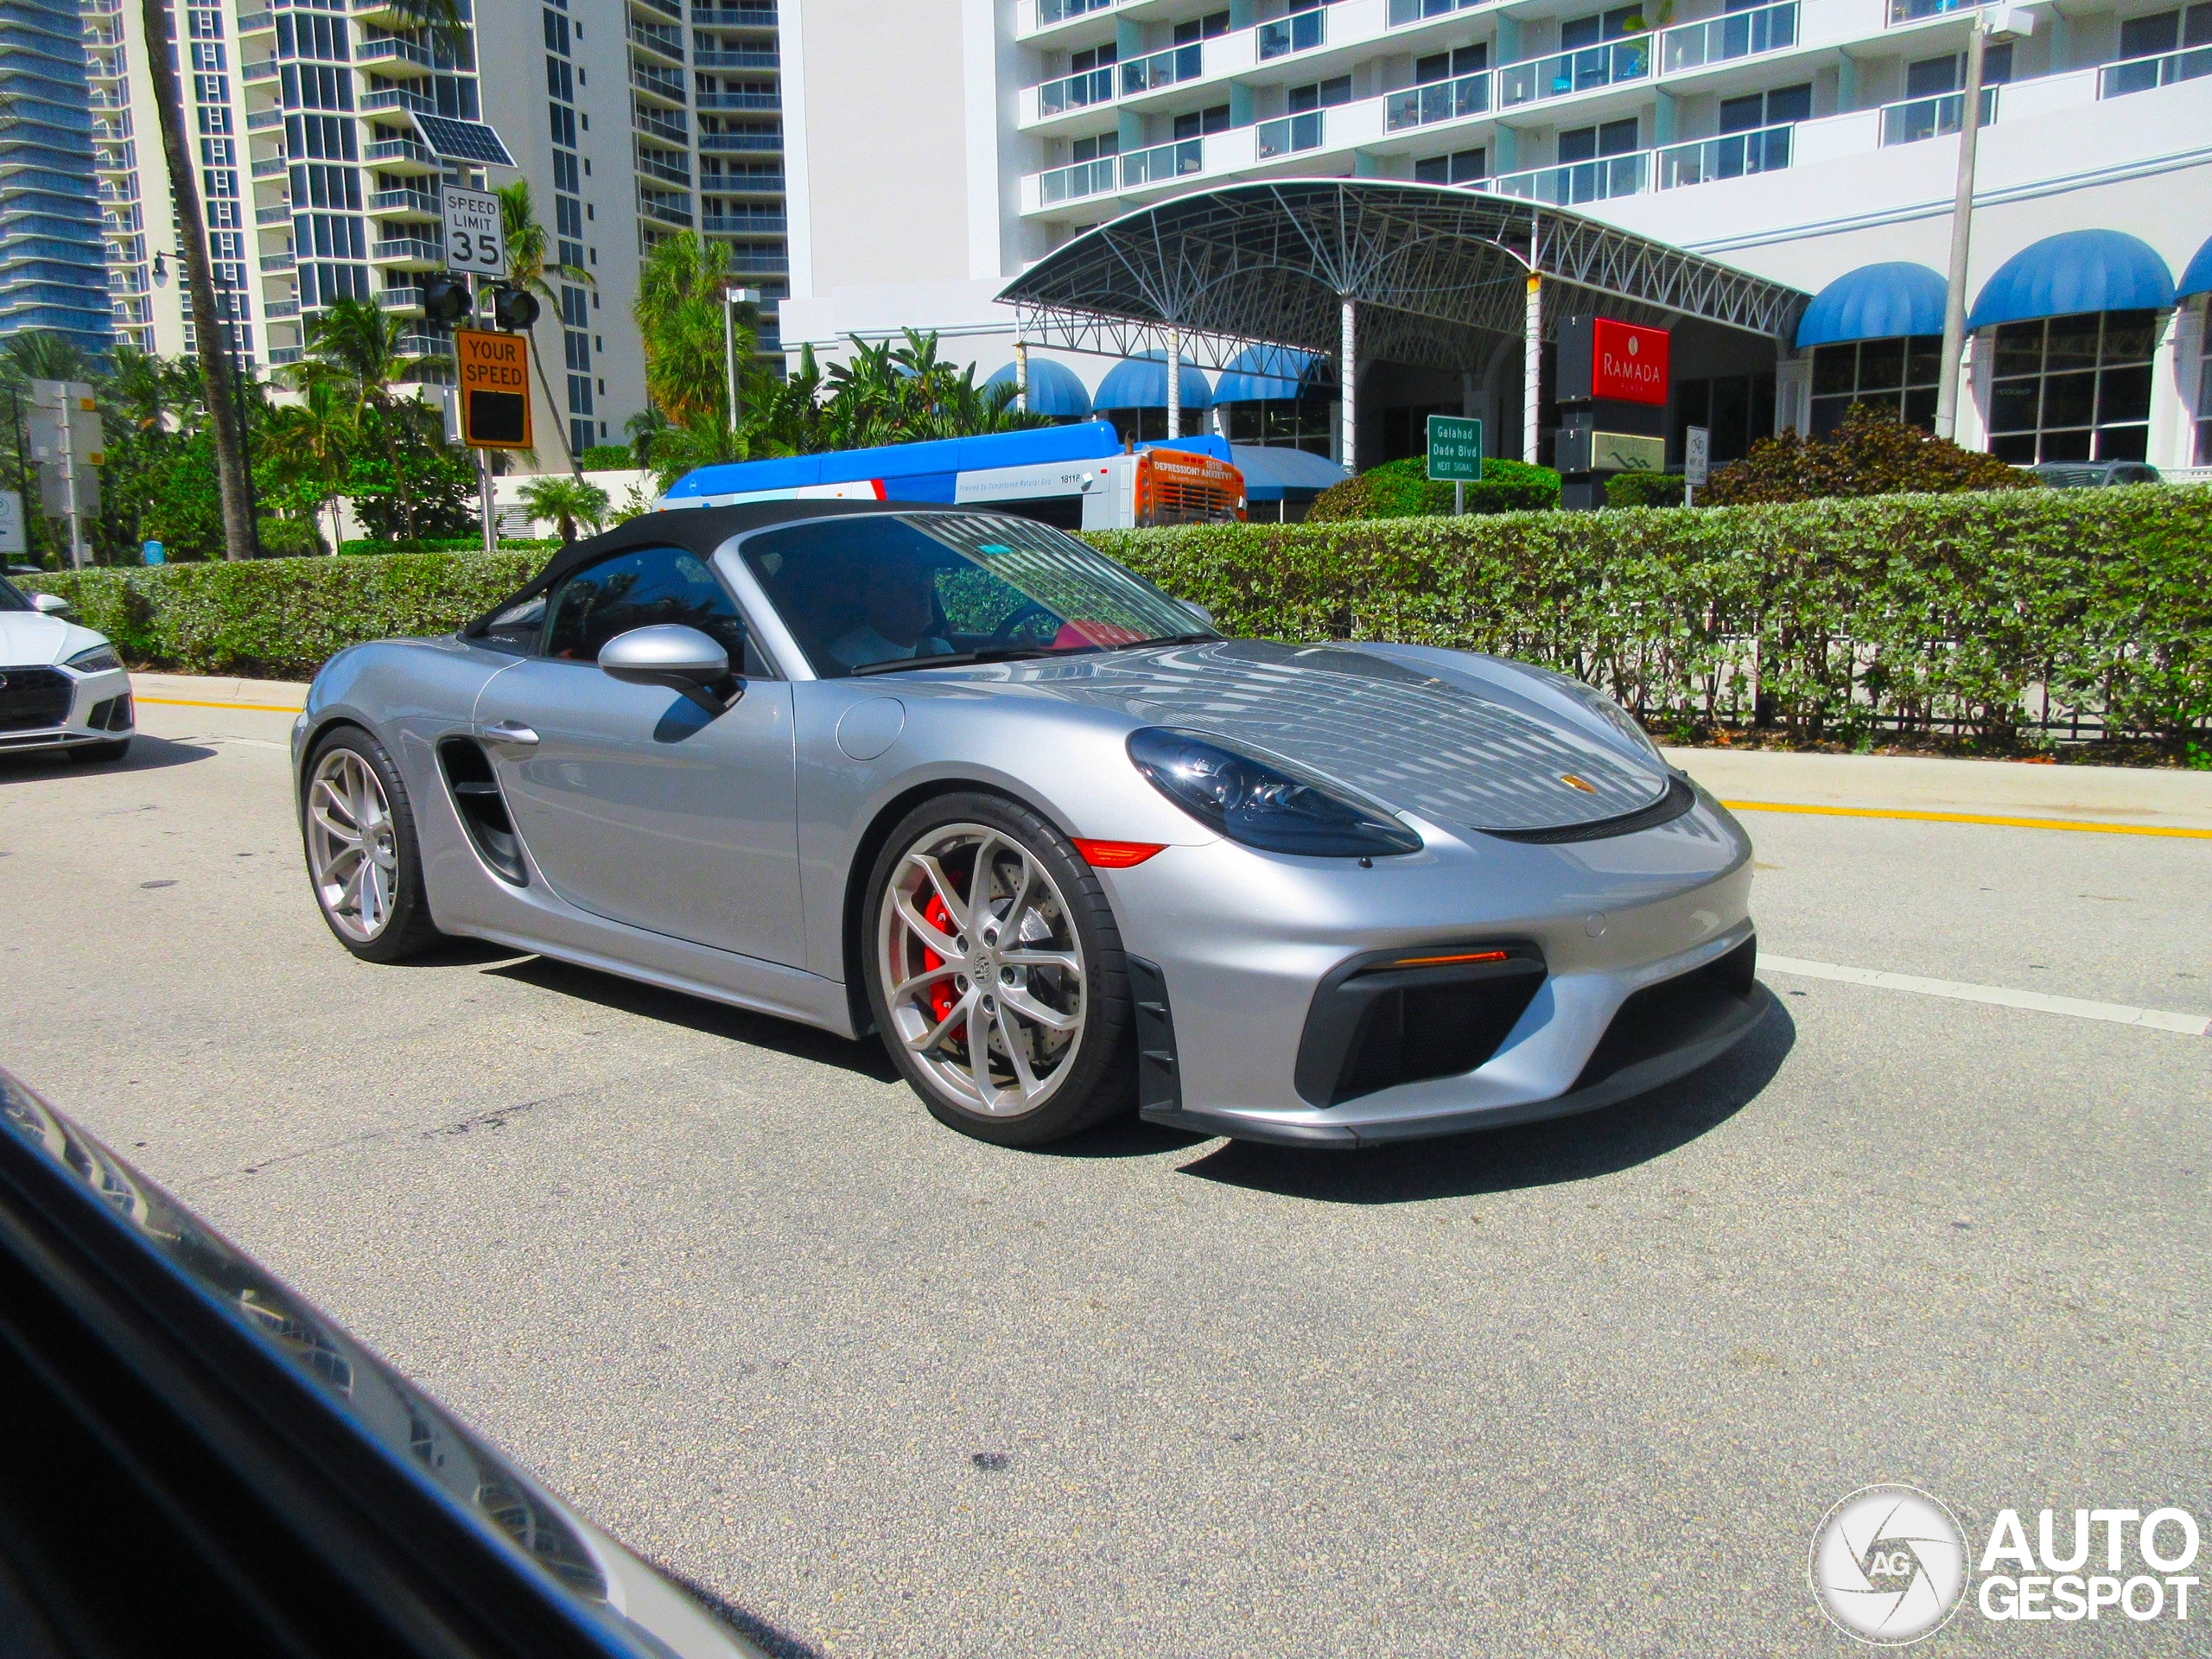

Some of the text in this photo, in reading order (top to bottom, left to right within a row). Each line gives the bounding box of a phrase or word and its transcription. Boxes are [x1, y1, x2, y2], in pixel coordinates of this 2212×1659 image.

[448, 195, 496, 215] SPEED
[454, 213, 492, 231] LIMIT
[452, 232, 499, 265] 35
[468, 340, 516, 362] YOUR
[467, 363, 522, 386] SPEED
[1604, 353, 1660, 383] RAMADA
[1437, 426, 1472, 439] Galahad
[1433, 443, 1477, 458] Dade Blvd
[1154, 461, 1232, 480] DEPRESSION? ANXIETY?
[1205, 460, 1223, 471] 18118
[1437, 461, 1472, 473] NEXT SIGNAL
[958, 484, 980, 493] Powered
[988, 480, 1019, 490] Compressed
[1020, 479, 1039, 487] Natural
[1060, 474, 1081, 484] 18118
